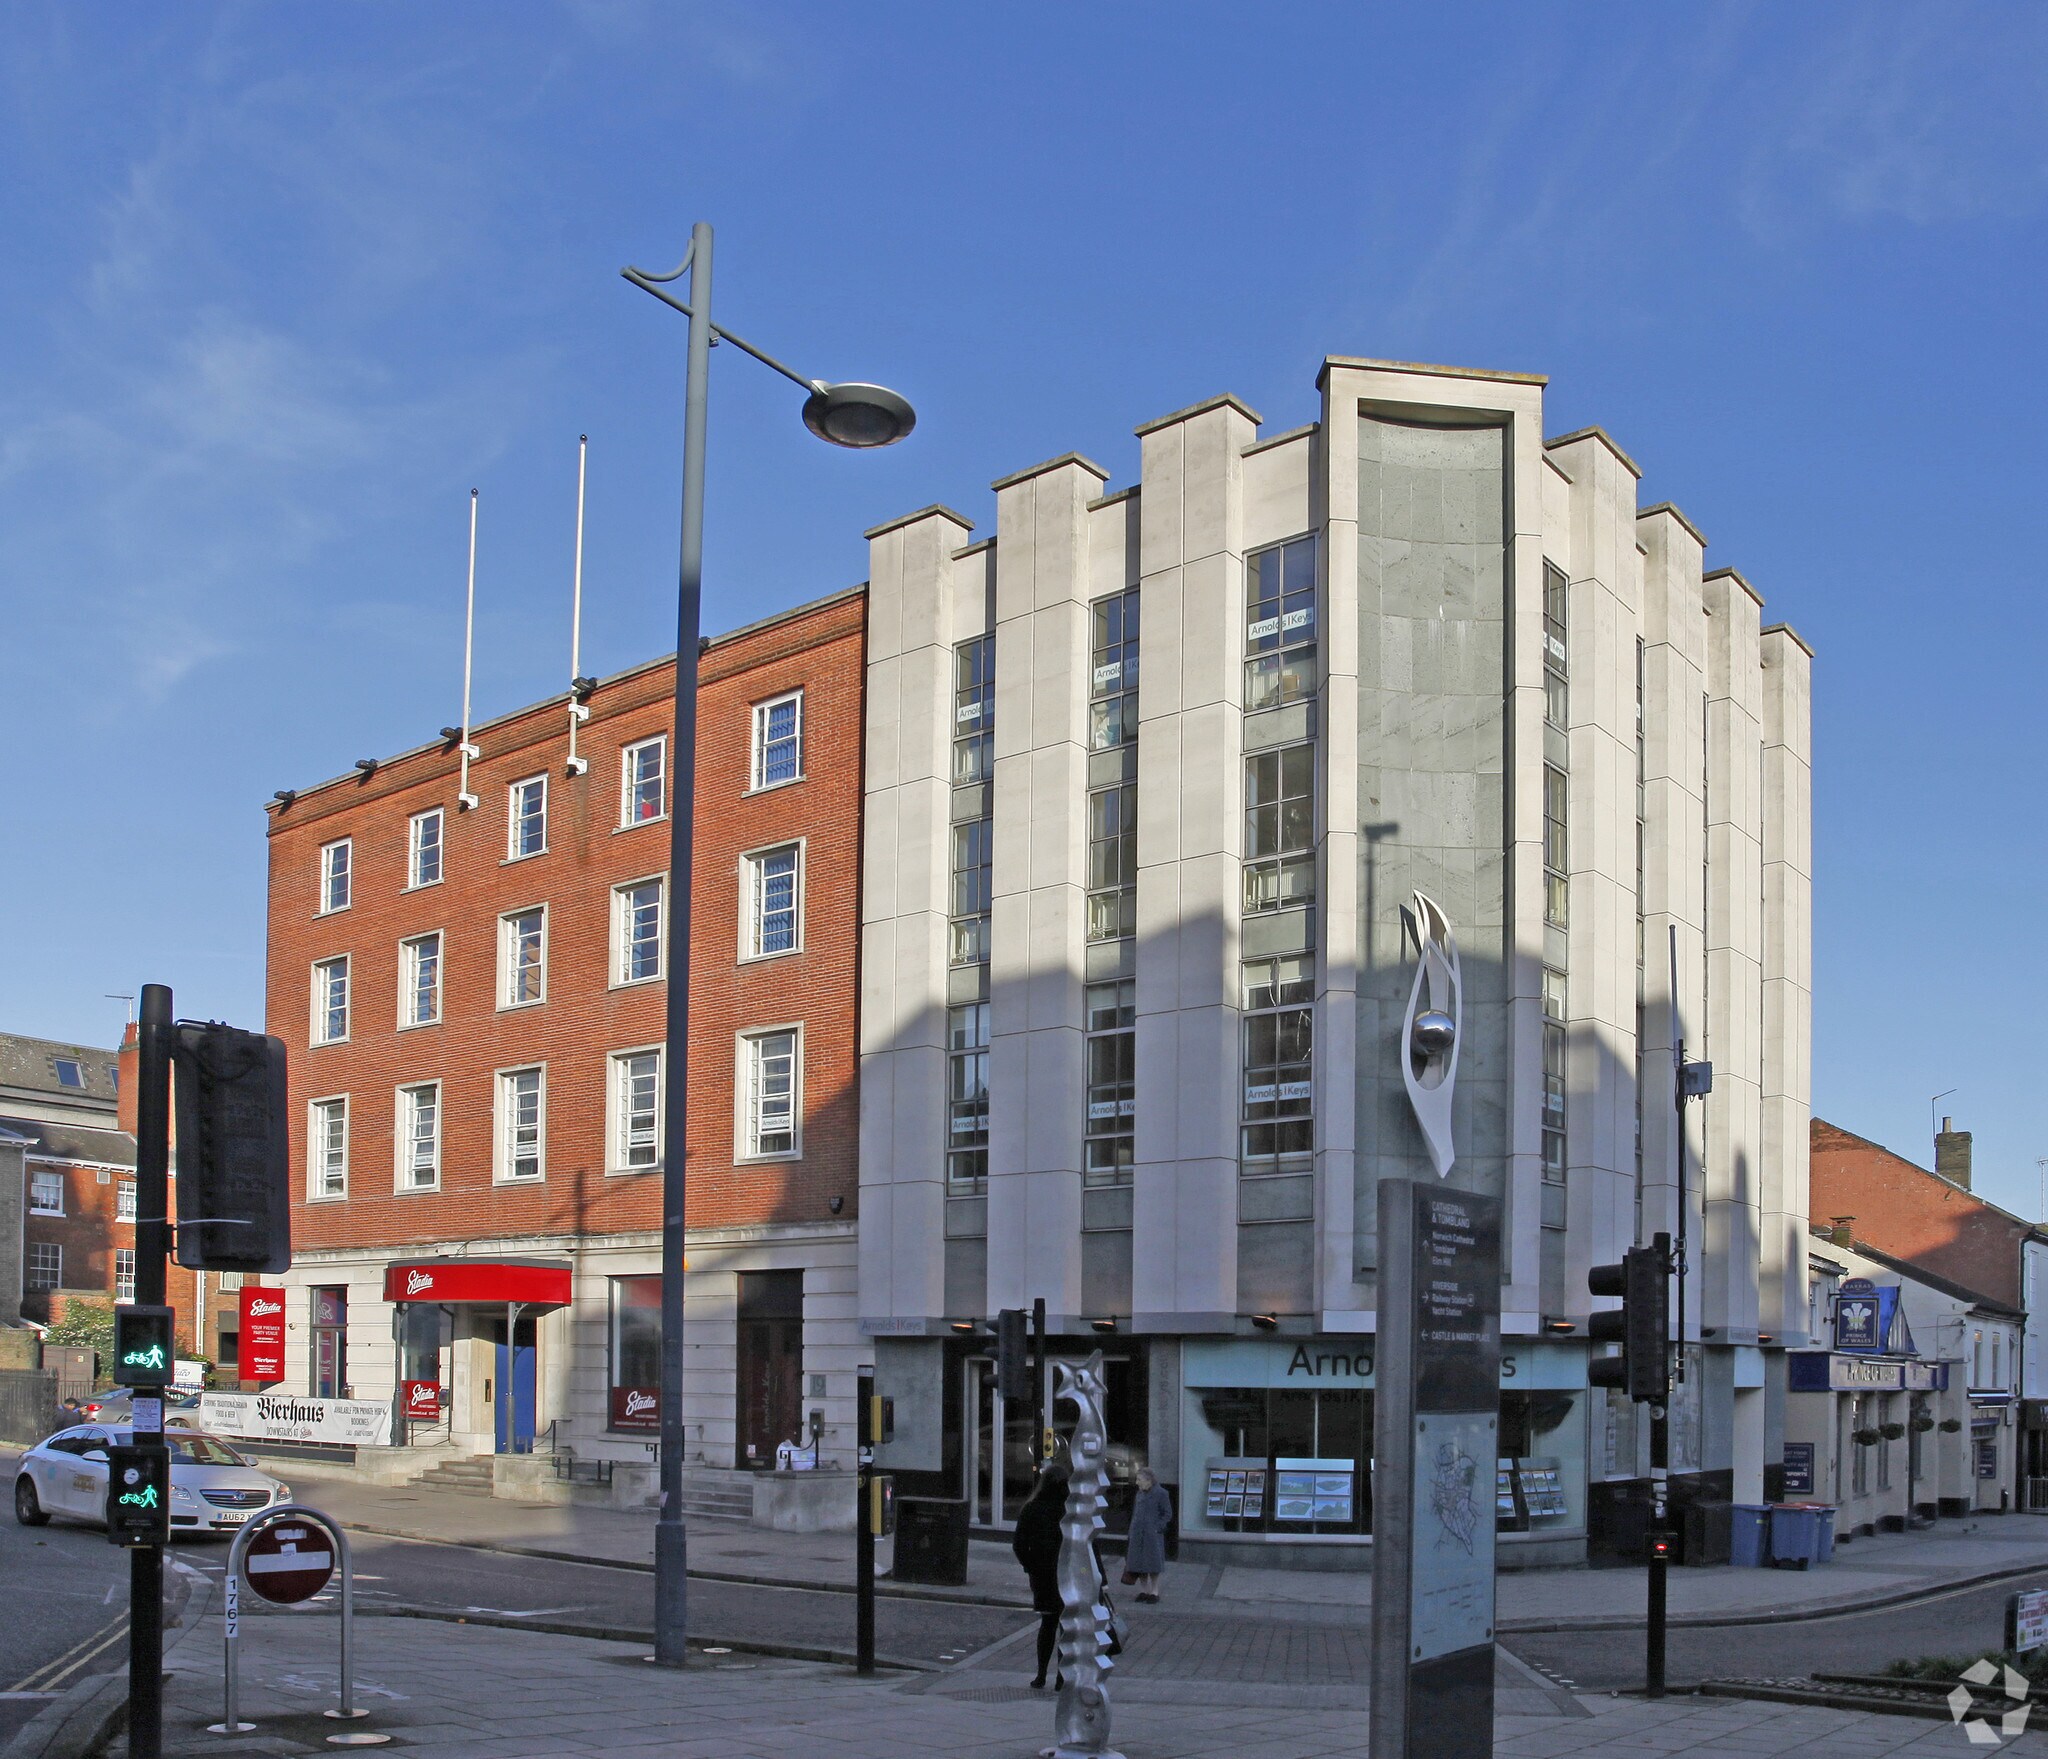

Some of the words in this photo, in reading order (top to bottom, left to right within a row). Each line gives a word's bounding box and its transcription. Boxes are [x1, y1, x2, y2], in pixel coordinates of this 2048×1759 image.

[1432, 1201, 1465, 1216] CATHEDRAL
[1439, 1214, 1470, 1228] TOMBLAND
[1453, 1234, 1475, 1245] Cathedral
[407, 1270, 434, 1295] Stadia
[250, 1299, 281, 1316] Stadia
[1432, 1331, 1451, 1340] CASTLE
[1456, 1332, 1475, 1341] MARKET
[411, 1384, 435, 1406] Stadia
[626, 1391, 656, 1416] Stadia
[257, 1397, 324, 1428] Bierhaus
[223, 1513, 245, 1521] AU62
